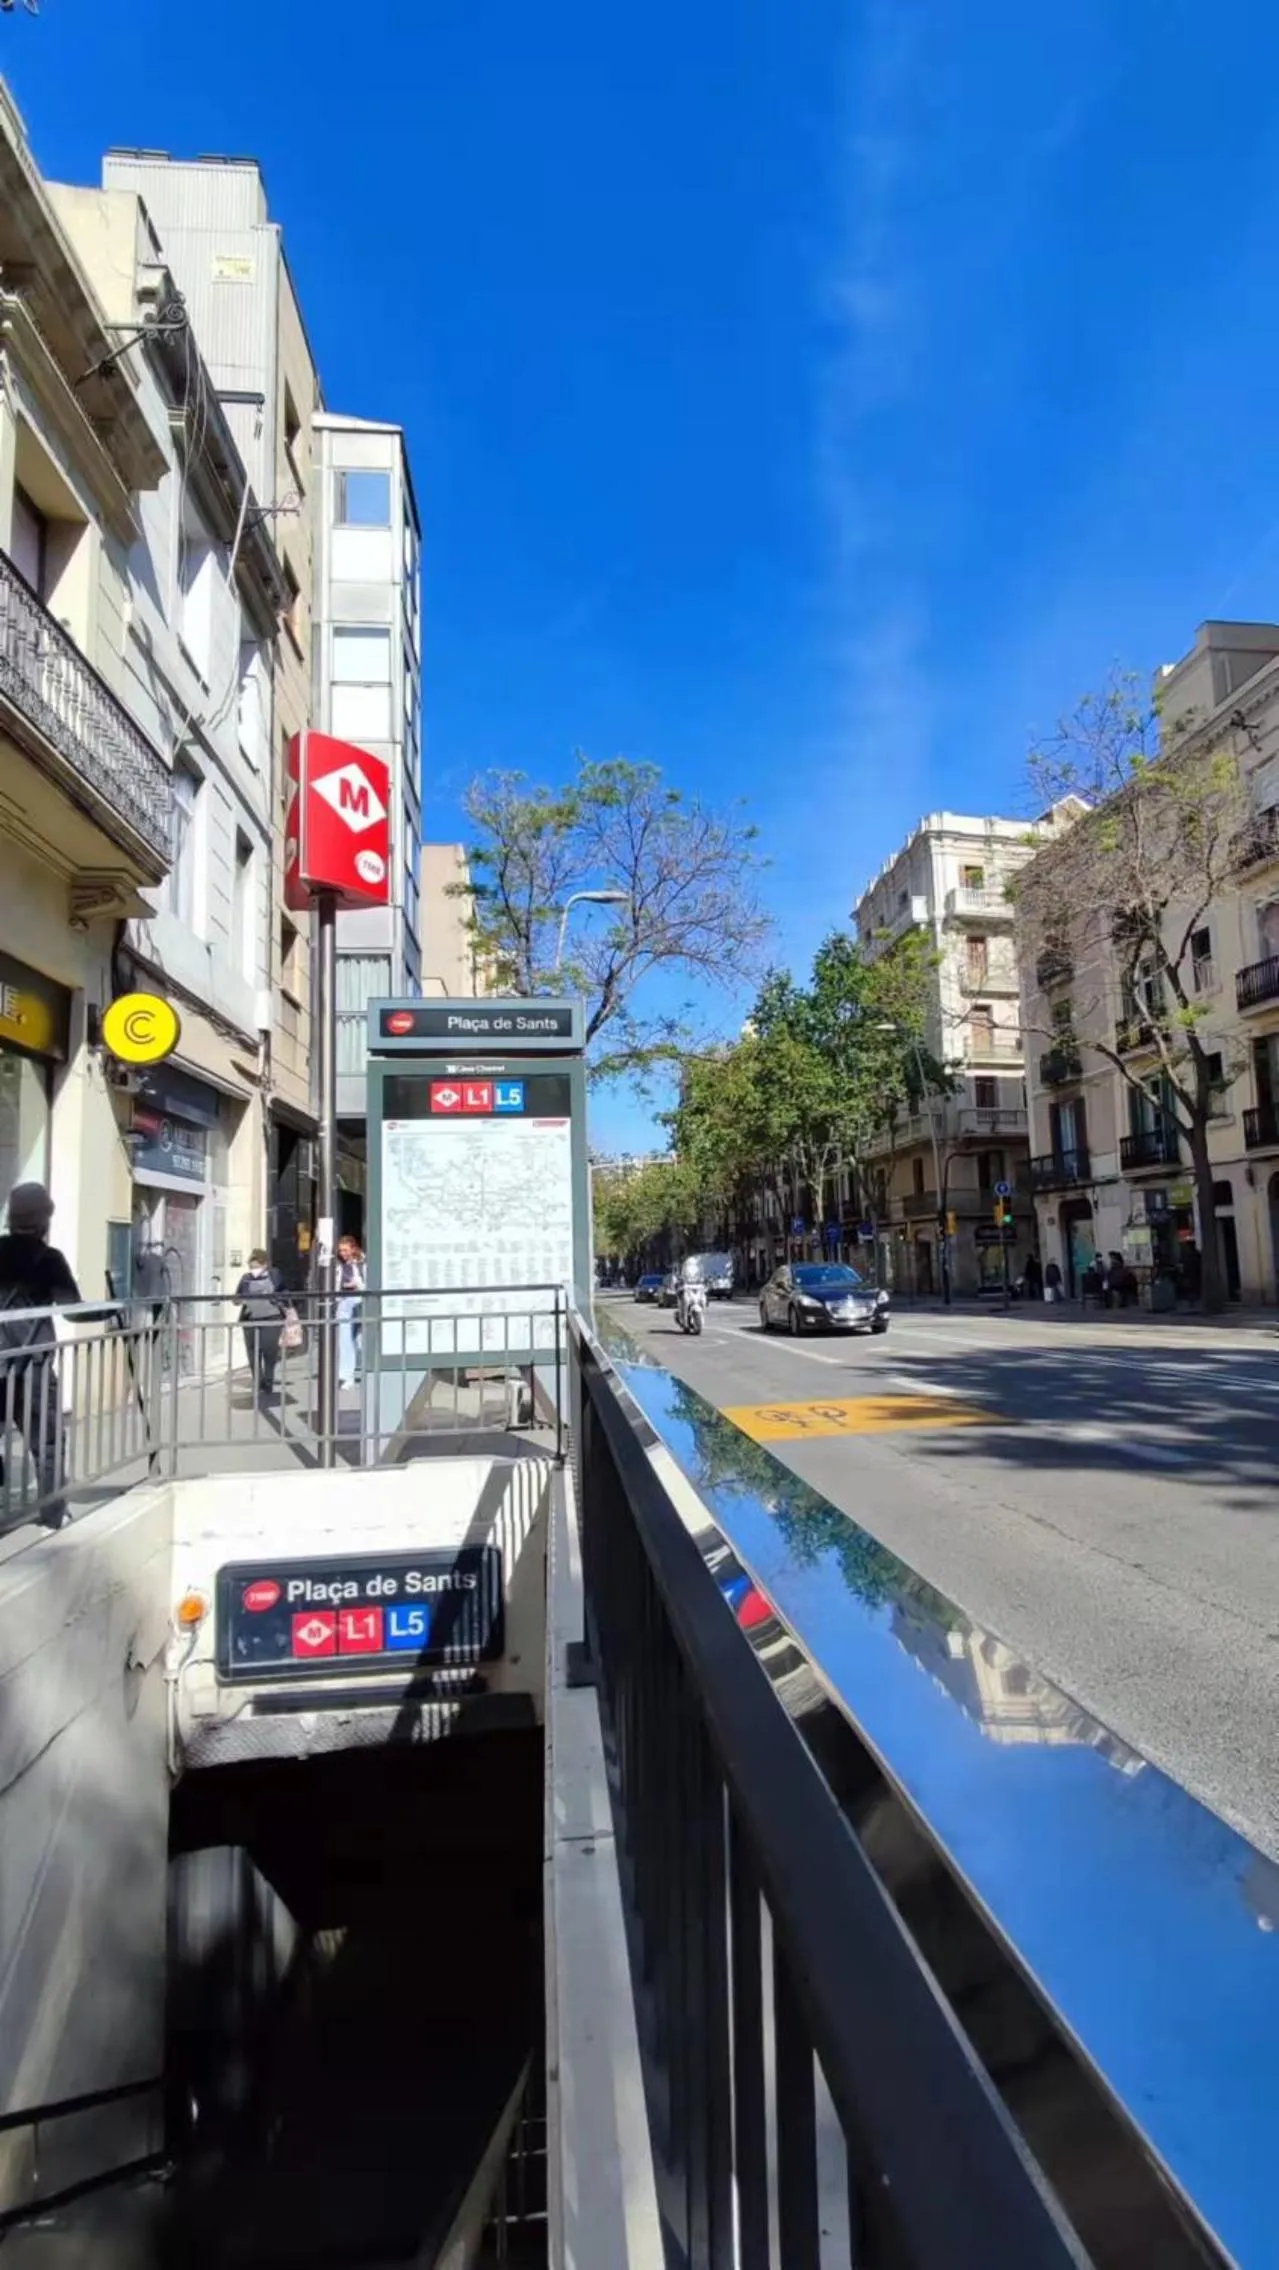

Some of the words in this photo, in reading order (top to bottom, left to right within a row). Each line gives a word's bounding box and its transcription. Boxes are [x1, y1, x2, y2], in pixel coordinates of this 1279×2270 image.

[338, 777, 369, 818] M
[447, 1016, 489, 1032] Plaça
[493, 1017, 512, 1030] de
[516, 1016, 558, 1030] Sants
[467, 1088, 489, 1105] L1
[496, 1088, 521, 1105] L5
[287, 1580, 359, 1605] Plaça
[365, 1574, 397, 1596] de
[404, 1571, 477, 1593] Sants
[346, 1613, 376, 1640] L1
[390, 1611, 425, 1636] L5
